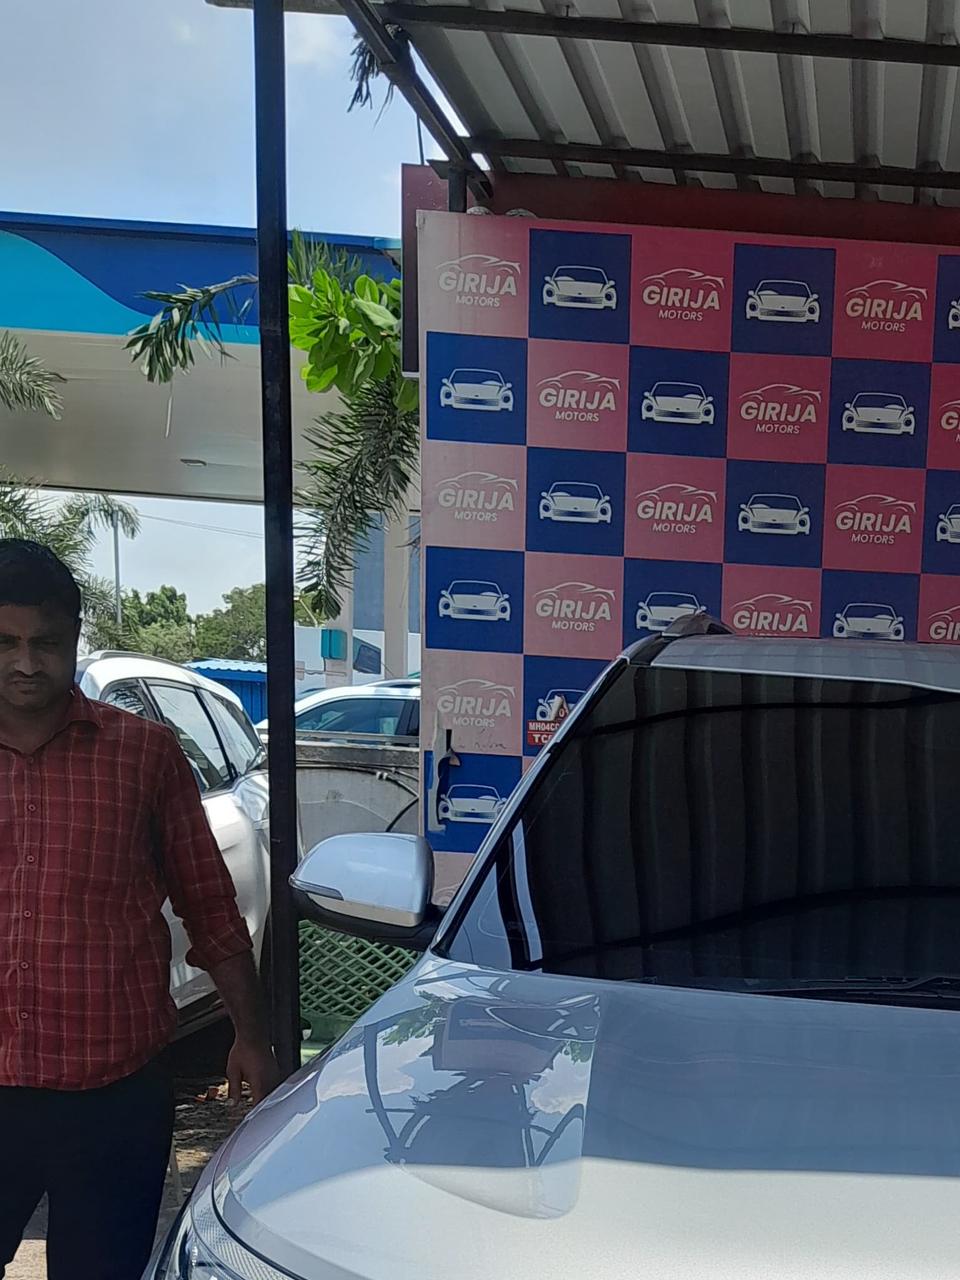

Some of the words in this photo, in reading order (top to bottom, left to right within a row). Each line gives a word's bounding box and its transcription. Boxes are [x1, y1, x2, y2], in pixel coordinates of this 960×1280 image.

[438, 271, 518, 296] GIRIJA
[455, 295, 501, 308] MOTORS
[642, 285, 720, 310] GIRIJA
[658, 309, 704, 322] MOTORS
[845, 298, 923, 321] GIRIJA
[861, 320, 906, 333] MOTORS
[539, 388, 616, 411] GIRIJA
[555, 410, 600, 423] MOTORS
[740, 401, 817, 424] GIRIJA
[755, 423, 800, 435] MOTORS
[437, 488, 514, 511] GIRIJA
[454, 510, 498, 523] MOTORS
[636, 500, 713, 523] GIRIJA
[835, 511, 912, 534] GIRIJA
[652, 522, 697, 535] MOTORS
[851, 533, 895, 545] MOTORS
[535, 599, 612, 621] GIRIJA
[551, 620, 596, 632] MOTORS
[733, 610, 808, 633] GIRIJA
[436, 694, 512, 717] GIRIJA
[452, 716, 496, 728] MOTORS
